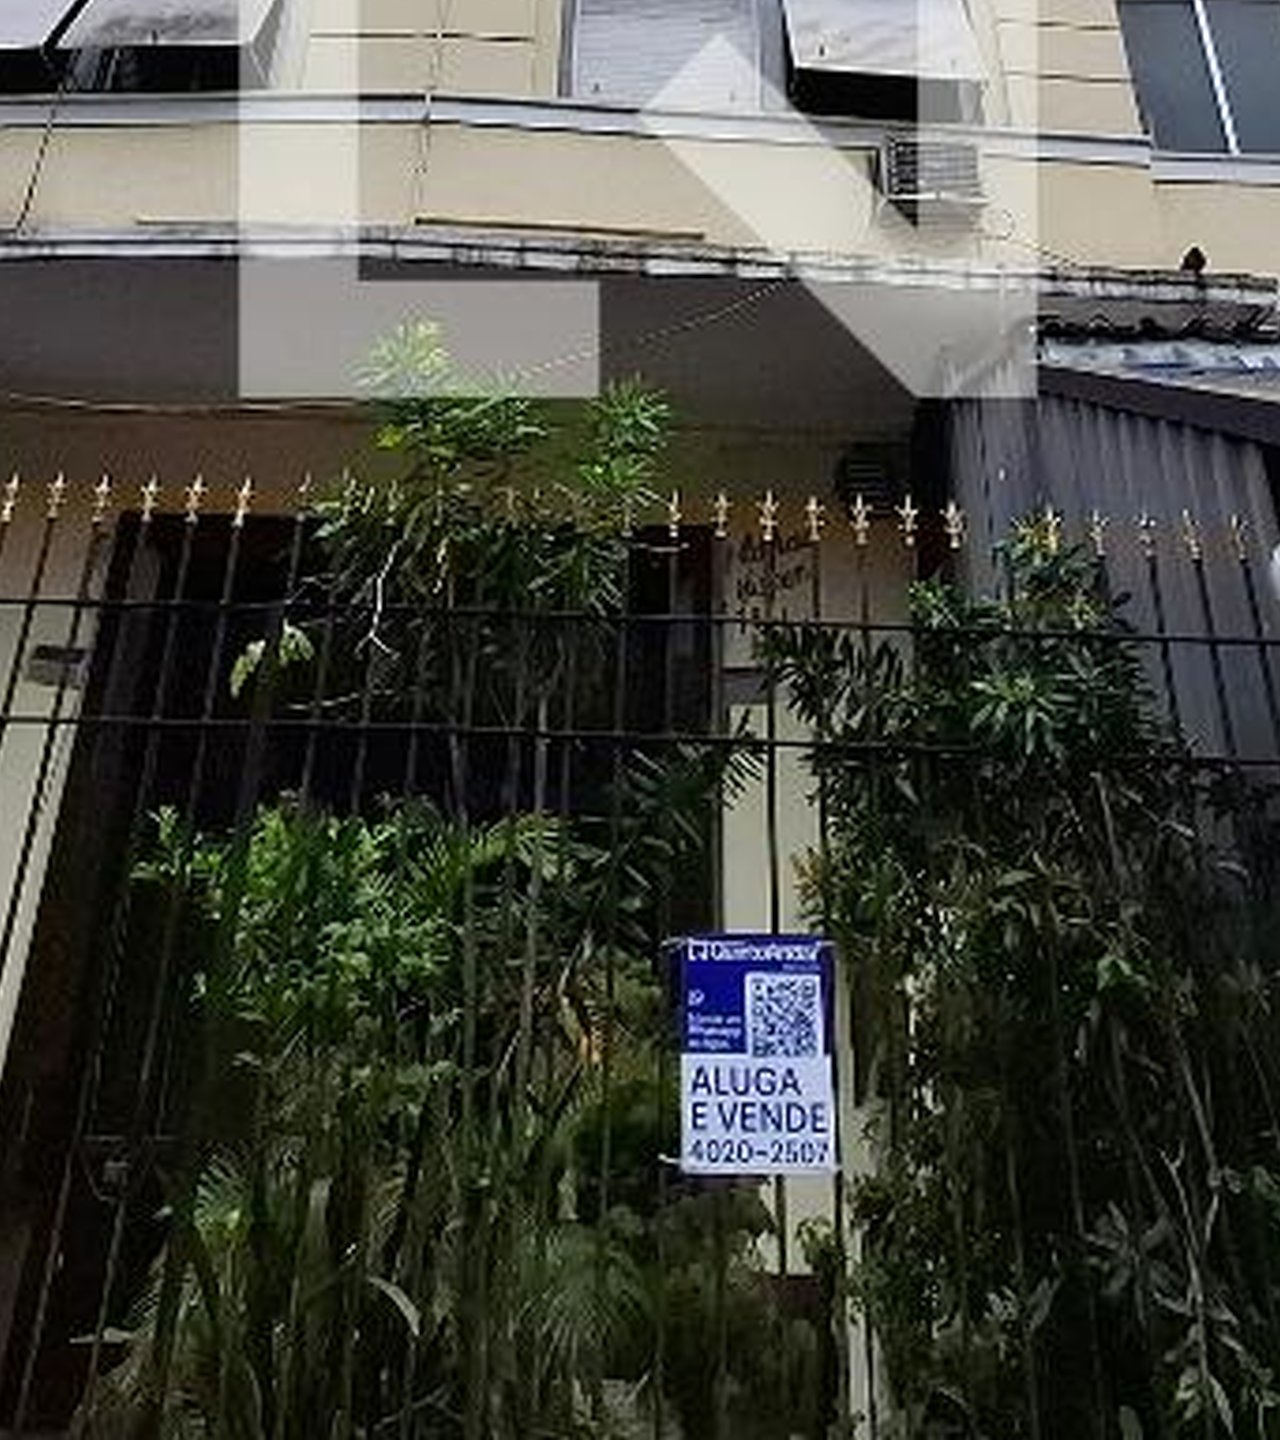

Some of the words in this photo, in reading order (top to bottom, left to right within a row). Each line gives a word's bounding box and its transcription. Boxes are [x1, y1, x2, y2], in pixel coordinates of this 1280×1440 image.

[692, 1066, 802, 1096] ALUGA
[692, 1102, 708, 1131] E
[718, 1102, 828, 1133] VENDE
[690, 1139, 829, 1164] 4020-2507
